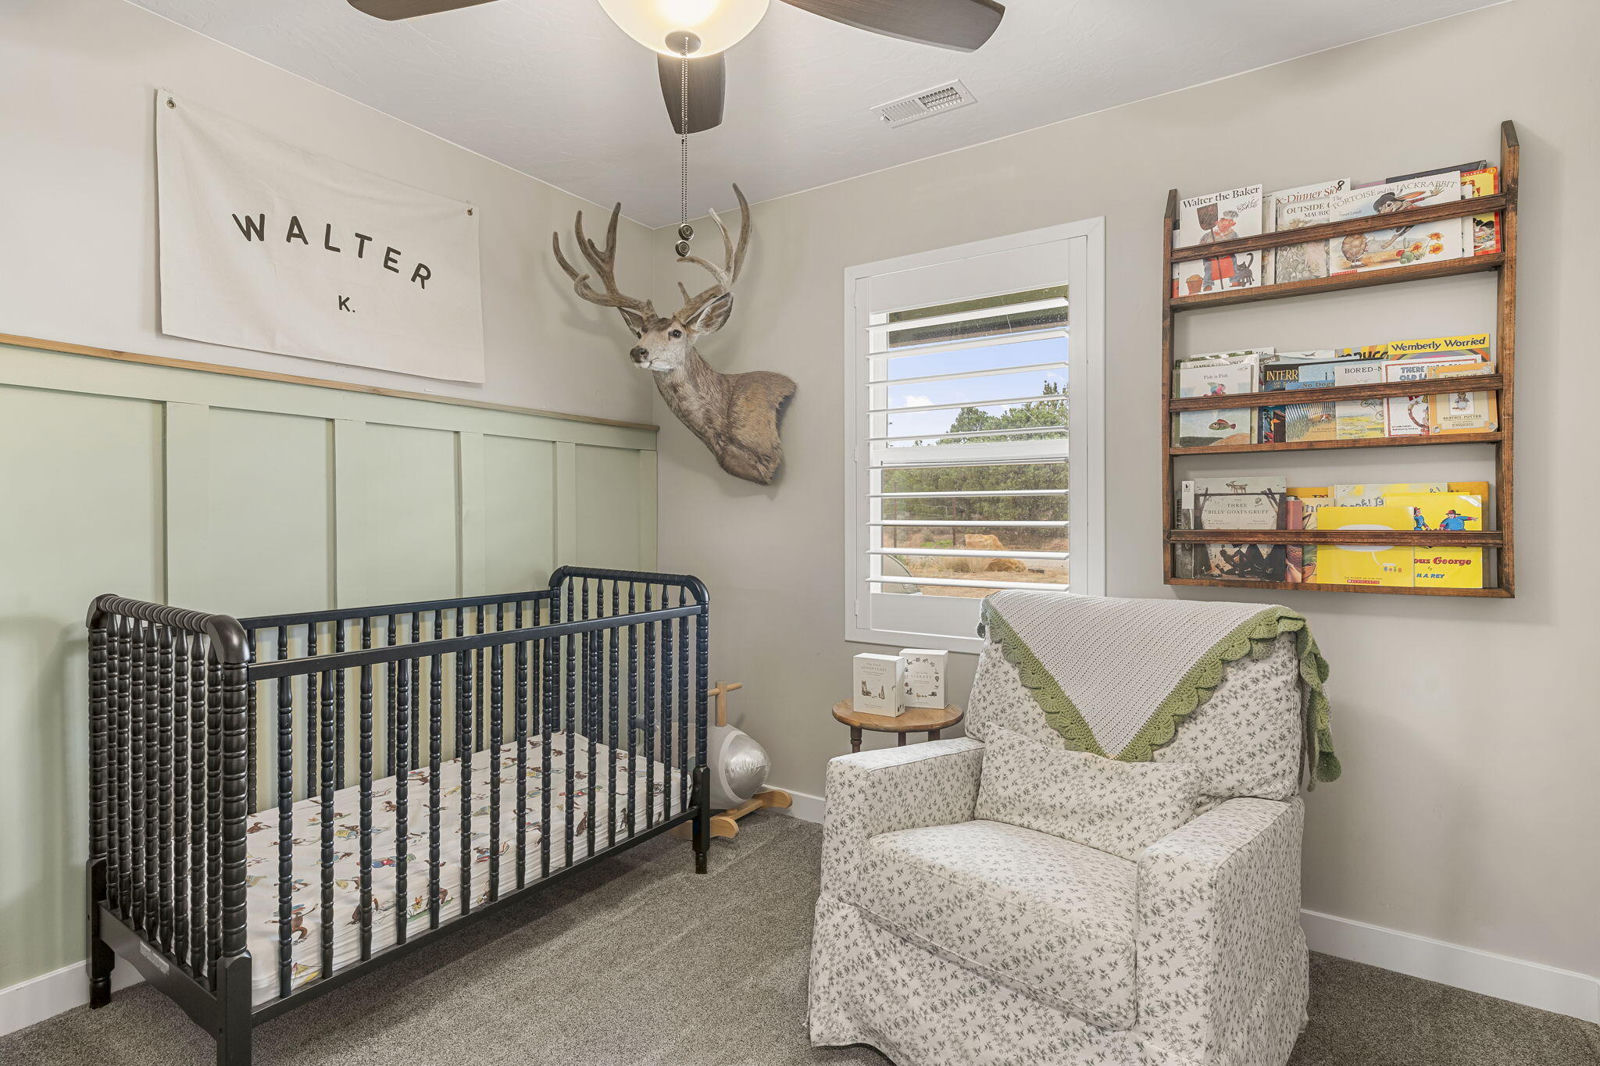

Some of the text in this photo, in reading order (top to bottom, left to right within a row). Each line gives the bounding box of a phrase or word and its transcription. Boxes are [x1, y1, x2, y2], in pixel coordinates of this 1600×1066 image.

[1183, 187, 1260, 208] Walter the Baker
[1332, 190, 1377, 210] TORTOISE
[1396, 180, 1458, 193] JACKRABBIT
[1287, 203, 1324, 215] OUTSIDE
[232, 213, 431, 289] WALTER
[338, 295, 355, 312] K.
[1391, 337, 1486, 352] Wemberly Worried
[1266, 370, 1299, 381] INTERR
[1400, 366, 1425, 374] THERE
[1433, 556, 1472, 566] George
